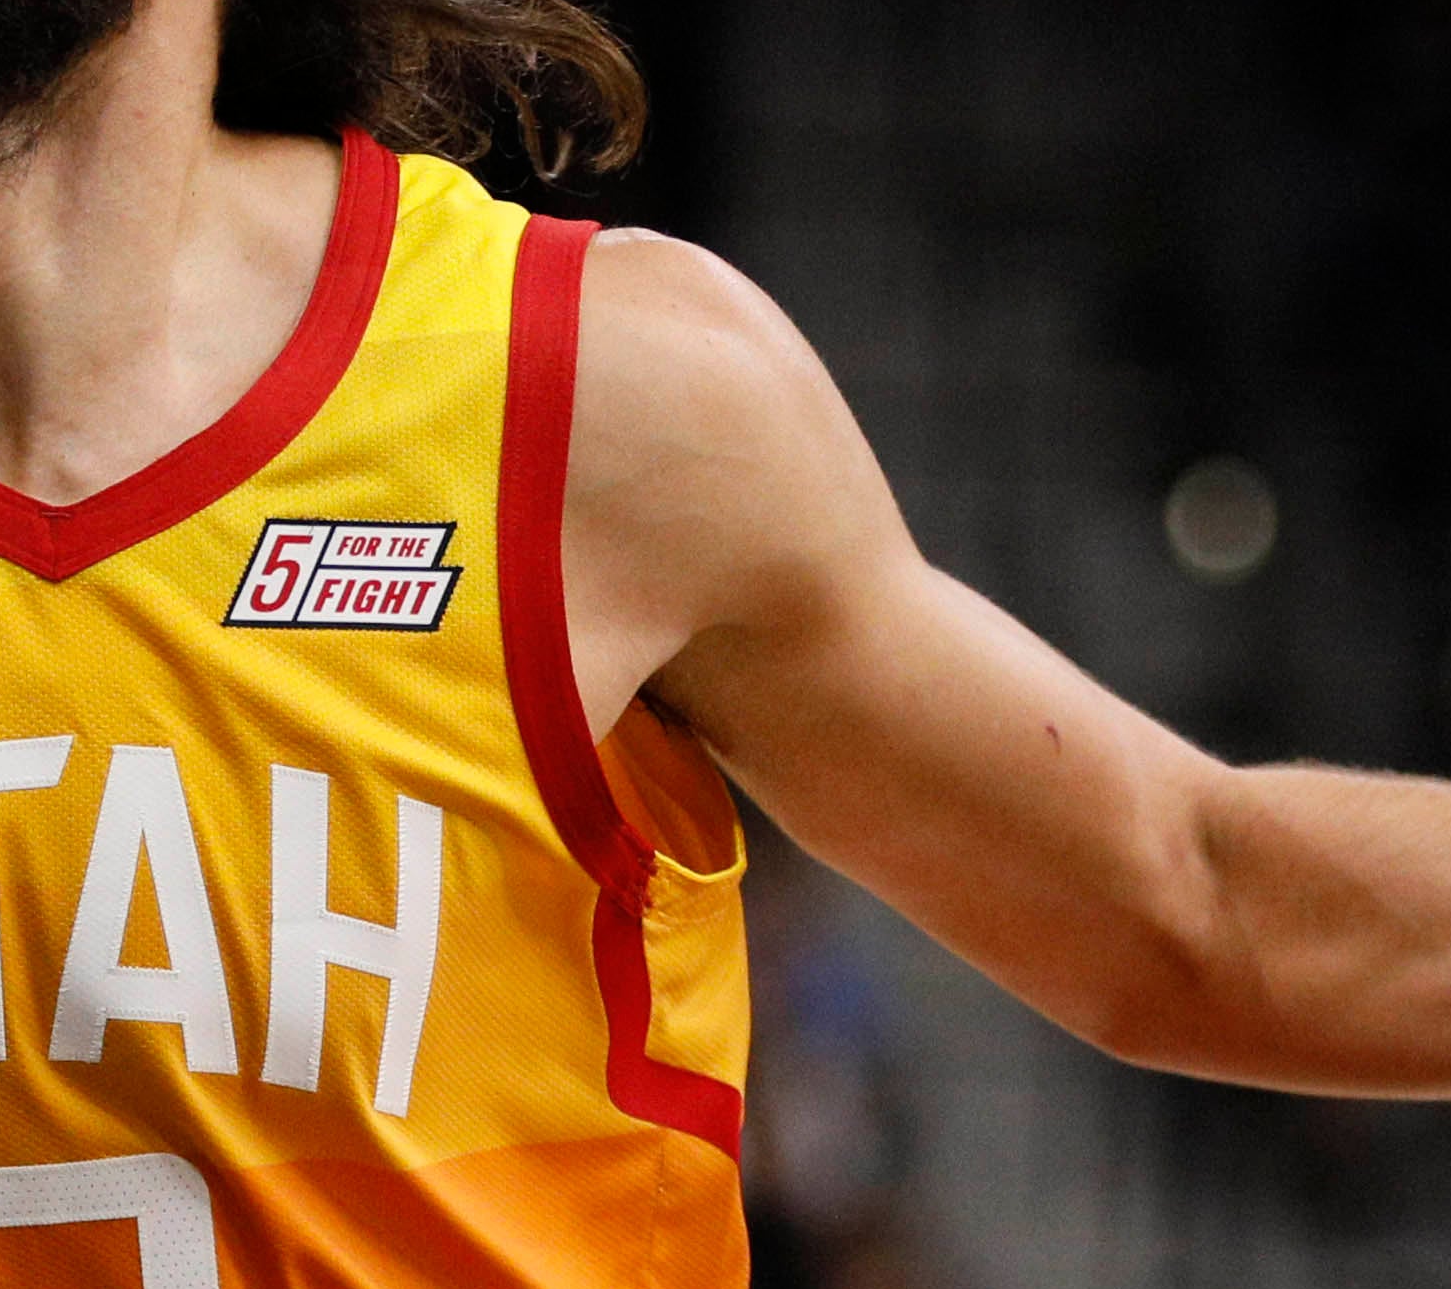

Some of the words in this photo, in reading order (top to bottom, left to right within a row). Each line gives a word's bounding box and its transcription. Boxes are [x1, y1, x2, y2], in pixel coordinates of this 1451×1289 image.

[337, 536, 381, 557] FOR
[386, 537, 430, 558] THE
[250, 535, 313, 612] 5
[312, 579, 437, 615] FIGHT
